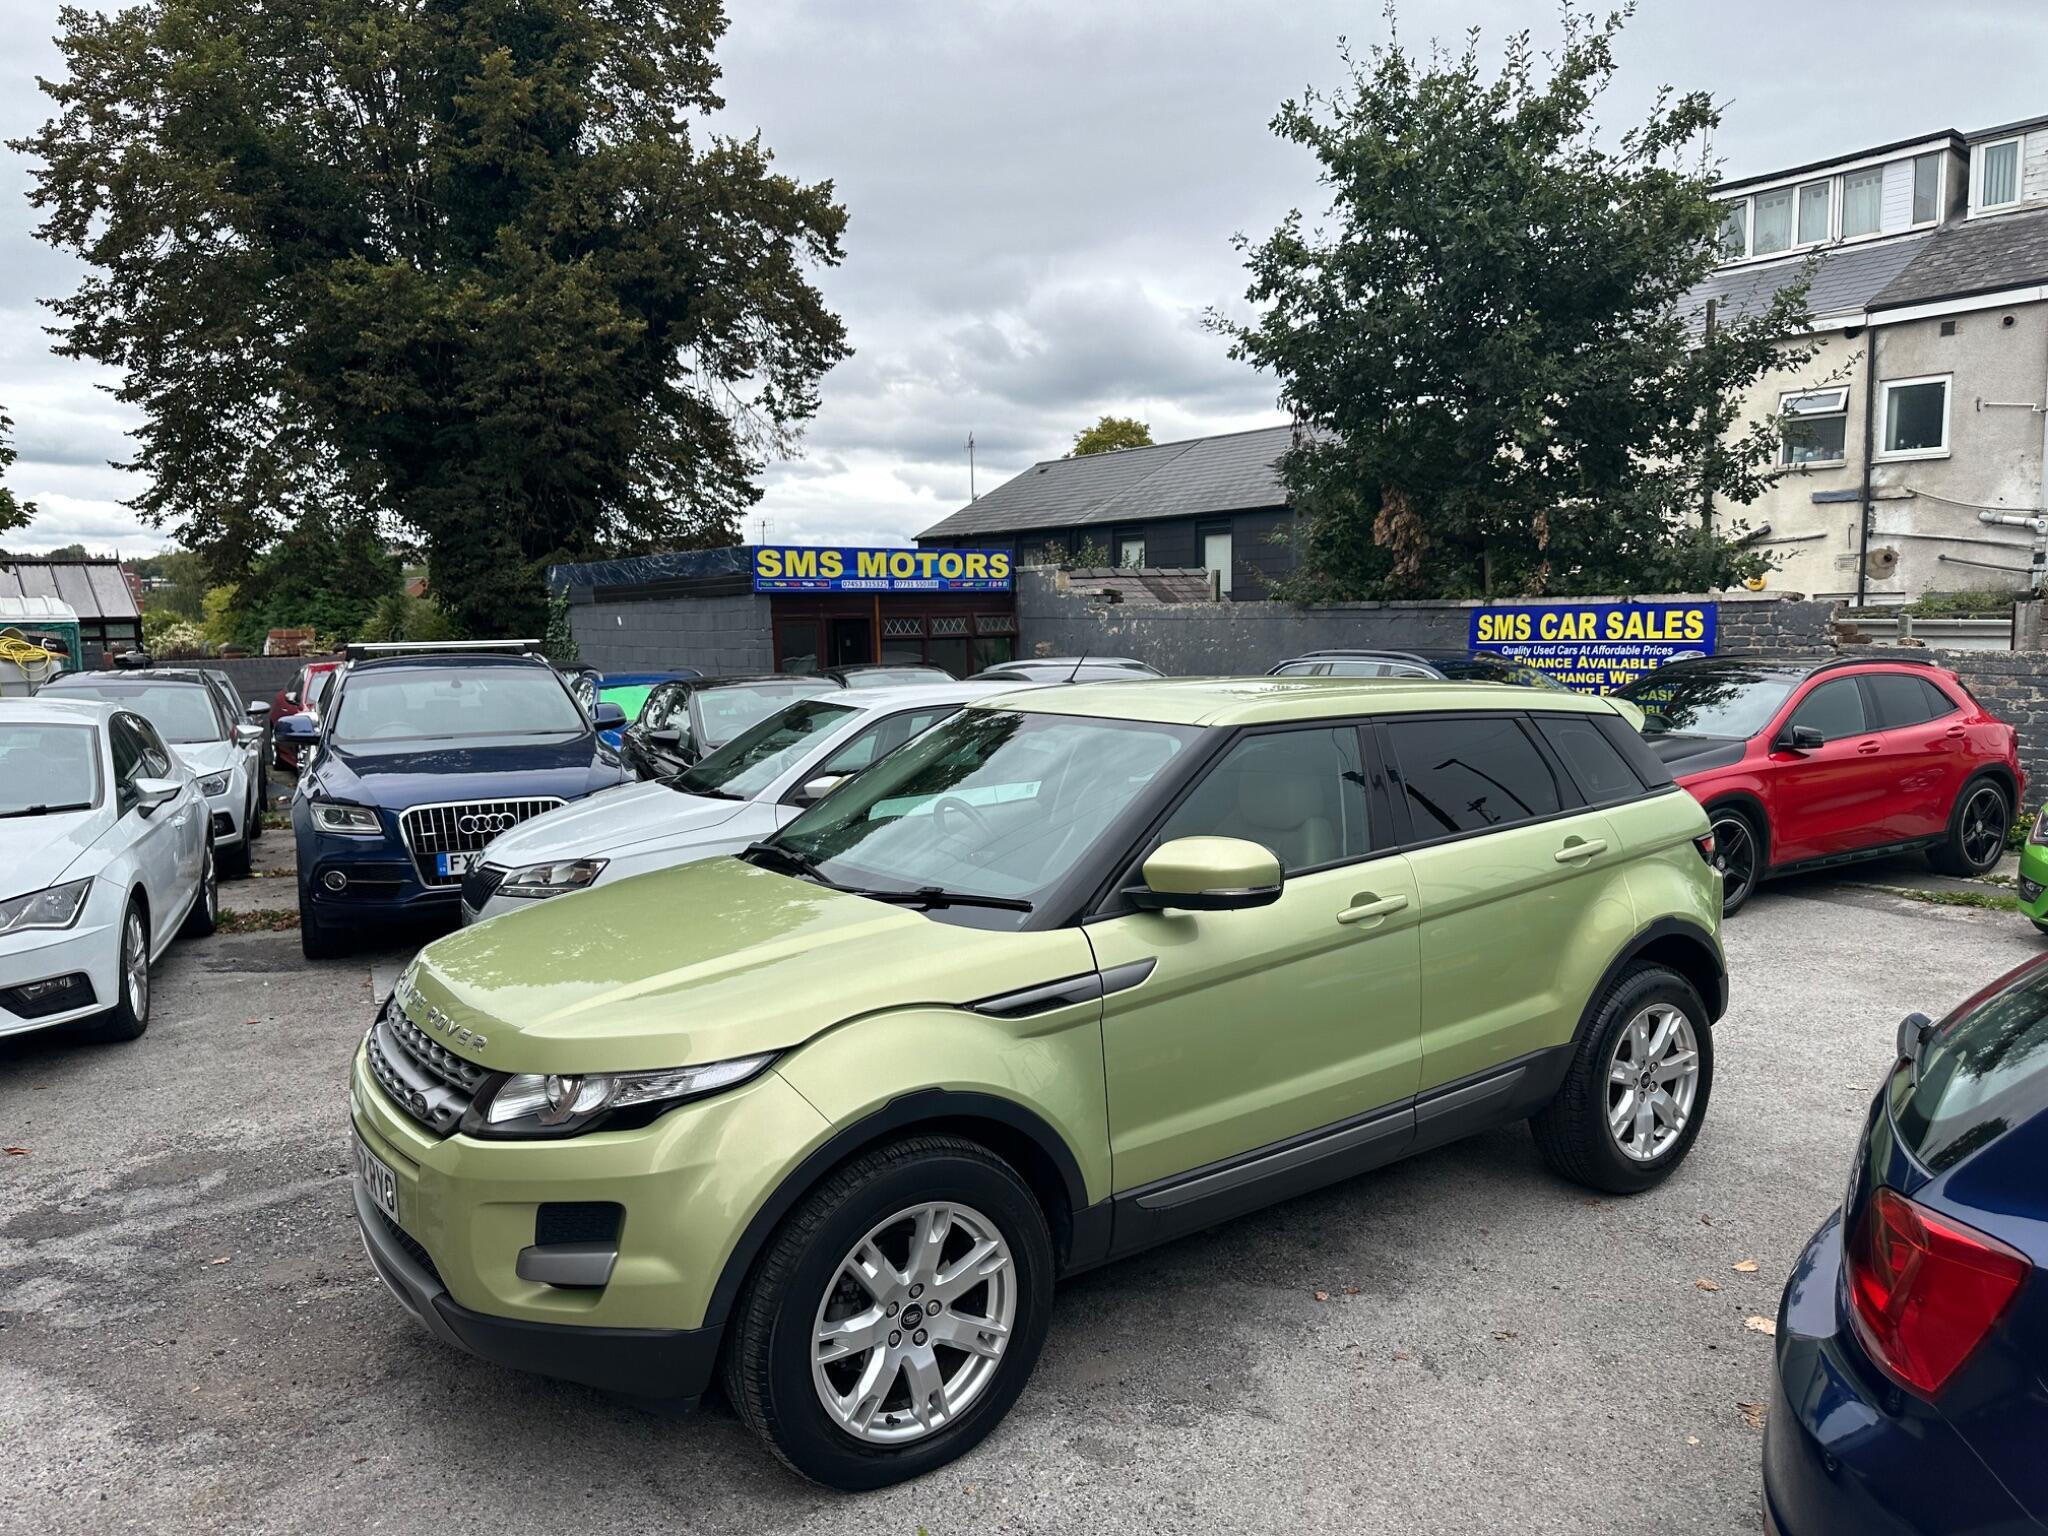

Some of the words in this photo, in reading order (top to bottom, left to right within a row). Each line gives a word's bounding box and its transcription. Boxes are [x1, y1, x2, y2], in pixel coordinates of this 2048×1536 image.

[757, 550, 844, 578] SMS
[857, 552, 1010, 579] MOTORS
[1478, 613, 1531, 641] SMS
[1540, 612, 1597, 640] CAR
[1605, 609, 1704, 640] SALES
[1502, 645, 1531, 656] Quality
[1533, 645, 1555, 655] Used
[1557, 645, 1577, 655] Cars
[1580, 645, 1589, 655] At
[1591, 645, 1640, 655] Affordable
[1642, 645, 1673, 655] Prices
[1514, 655, 1572, 668] FINANCE
[1577, 655, 1658, 669] AVAILABLE
[427, 1006, 488, 1053] ROVER
